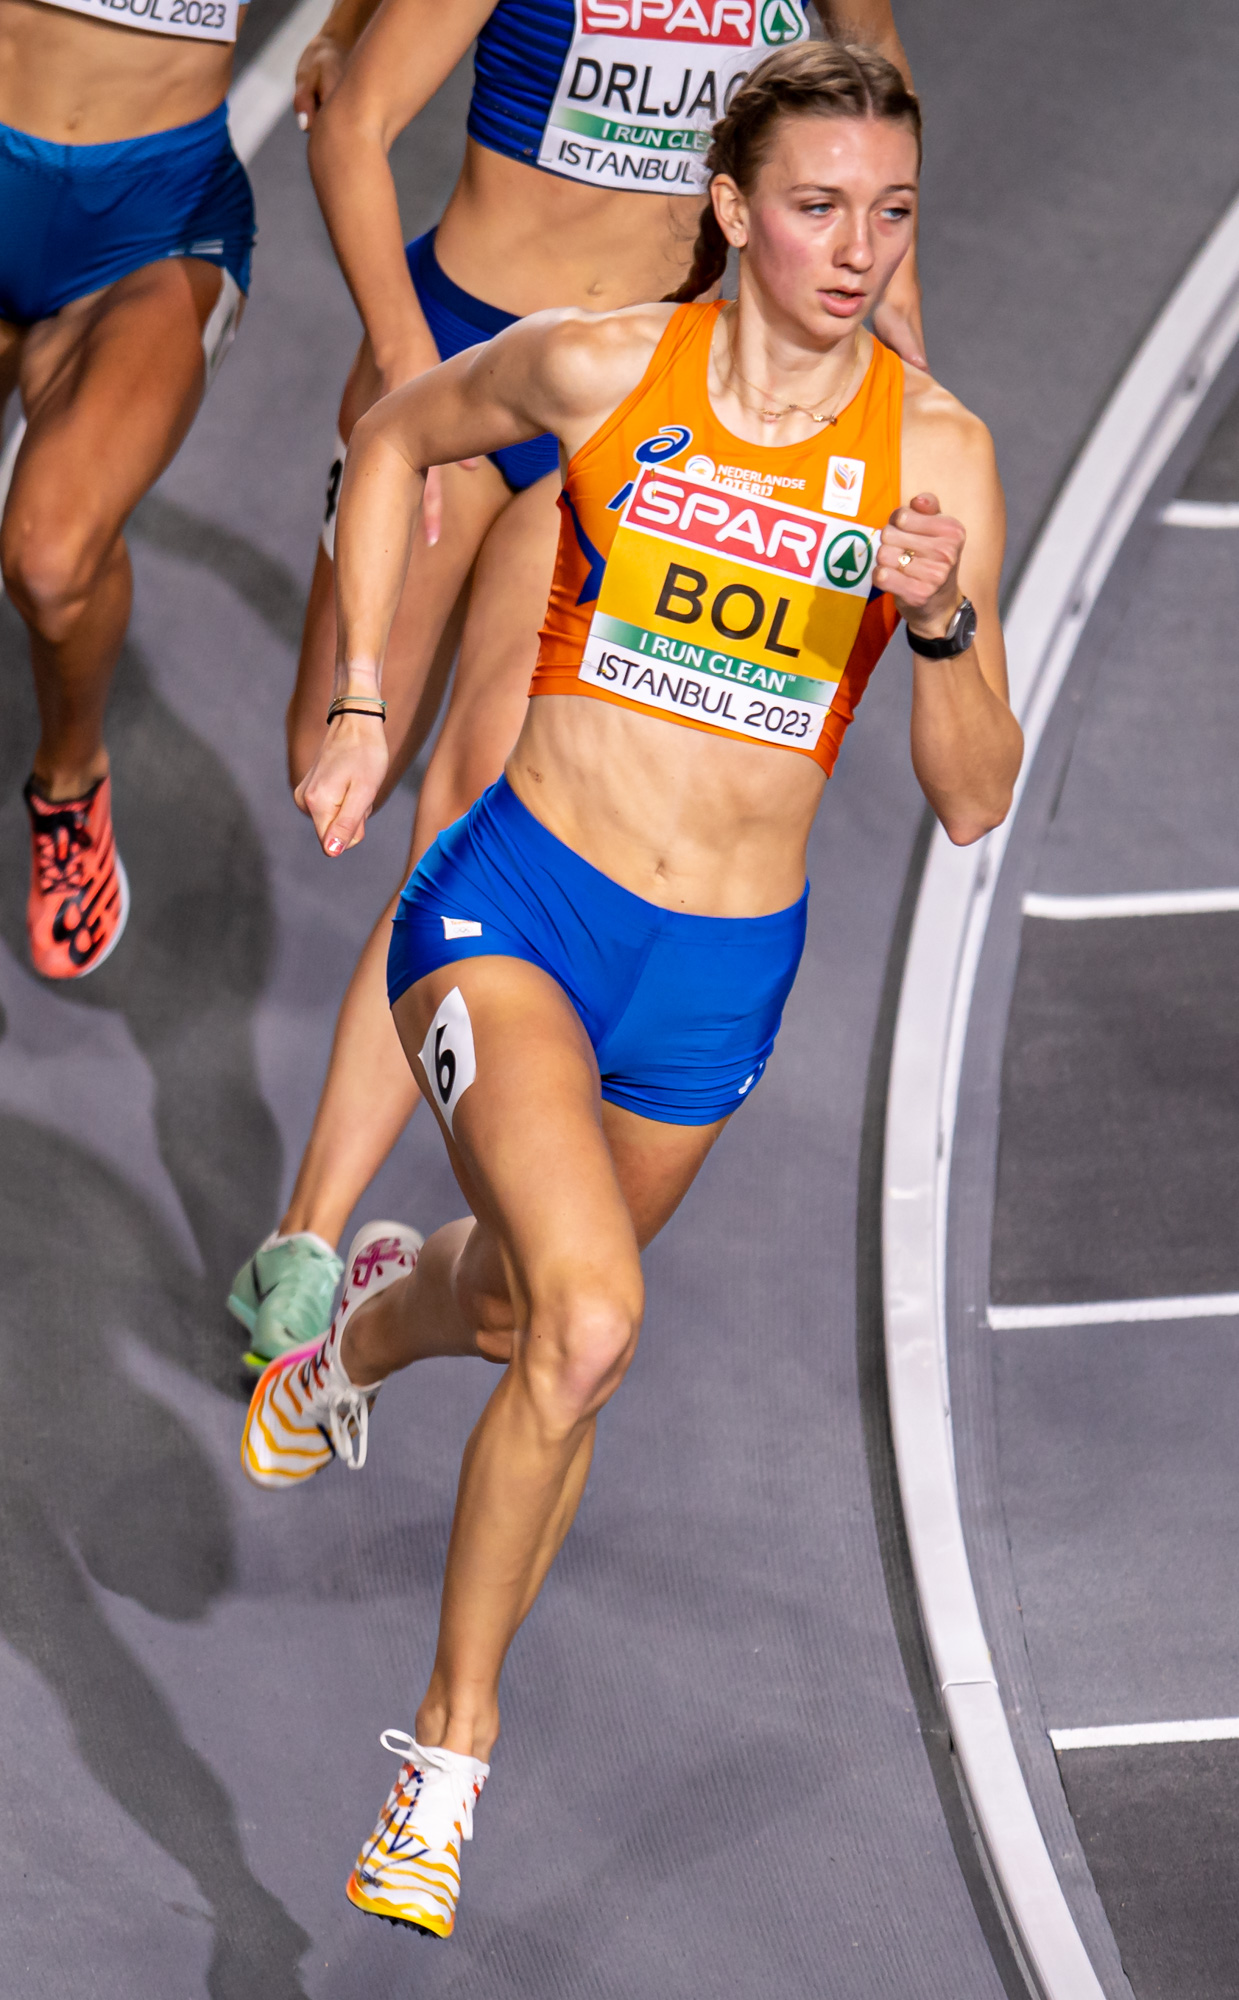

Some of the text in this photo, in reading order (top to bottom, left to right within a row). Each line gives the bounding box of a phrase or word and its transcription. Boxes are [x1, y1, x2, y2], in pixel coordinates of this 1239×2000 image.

[169, 0, 227, 29] 2023
[586, 0, 752, 40] SPAR
[601, 121, 612, 139] I
[614, 125, 664, 148] RUN
[558, 140, 695, 184] ISTANBUL
[716, 464, 807, 491] NEDERLANDSE
[635, 480, 818, 569] SPAR
[654, 561, 801, 659] BOL
[638, 631, 649, 651] I
[651, 636, 705, 668] RUN
[596, 651, 812, 738] ISTANBUL 2023
[434, 1022, 456, 1105] 6
